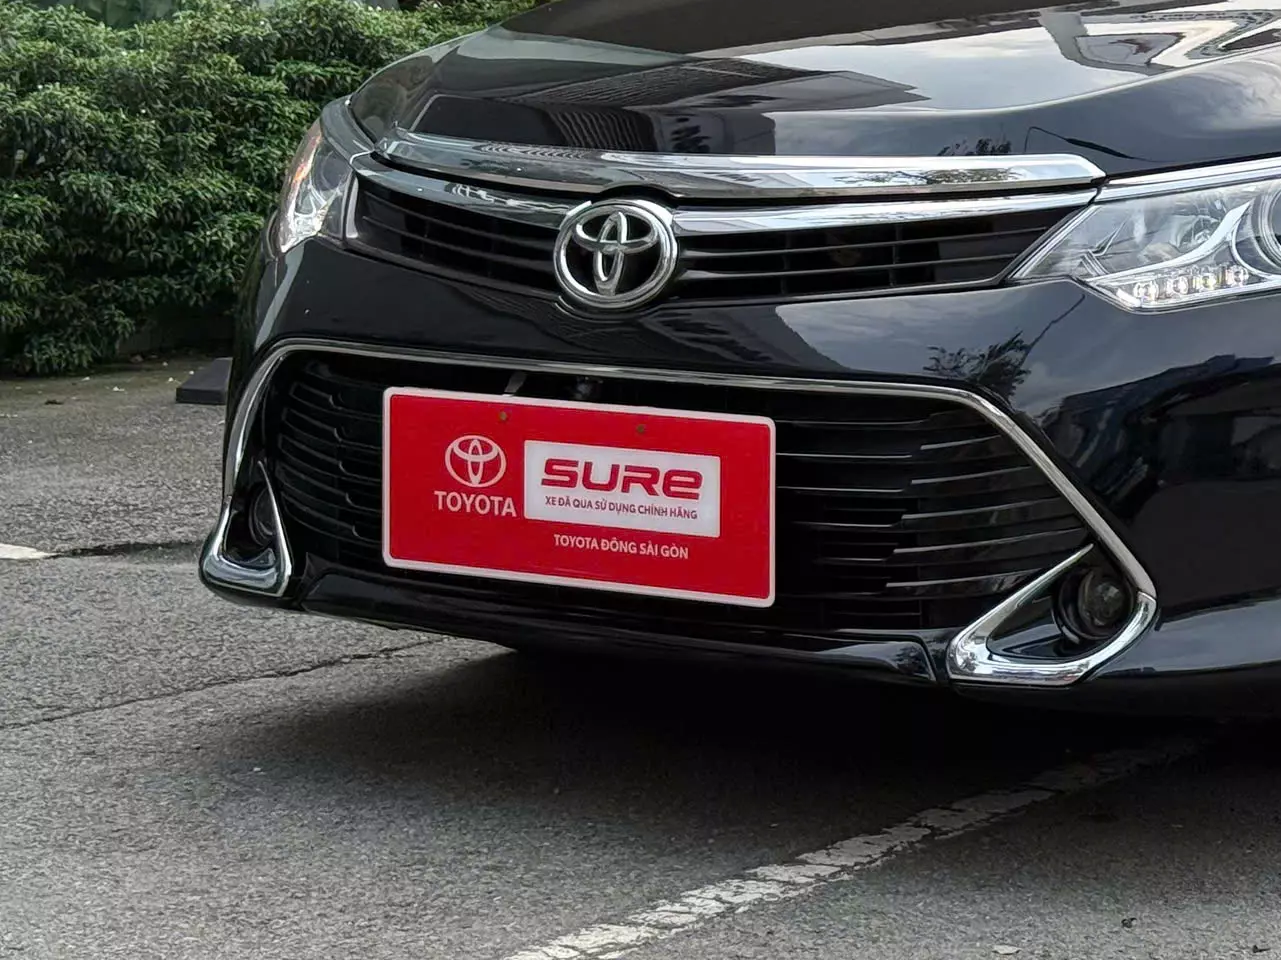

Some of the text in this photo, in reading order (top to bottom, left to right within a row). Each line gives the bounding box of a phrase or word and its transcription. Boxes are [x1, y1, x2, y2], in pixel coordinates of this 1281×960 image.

[434, 490, 517, 518] TOYOTA
[545, 496, 557, 506] XE
[558, 495, 571, 507] ĐÃ
[573, 498, 593, 510] QUA
[595, 498, 607, 512] SỬ
[608, 502, 636, 515] DỤNG
[638, 504, 668, 517] CHÍNH
[553, 534, 689, 559] TOYOTA ĐÔNG SÀI GÒN
